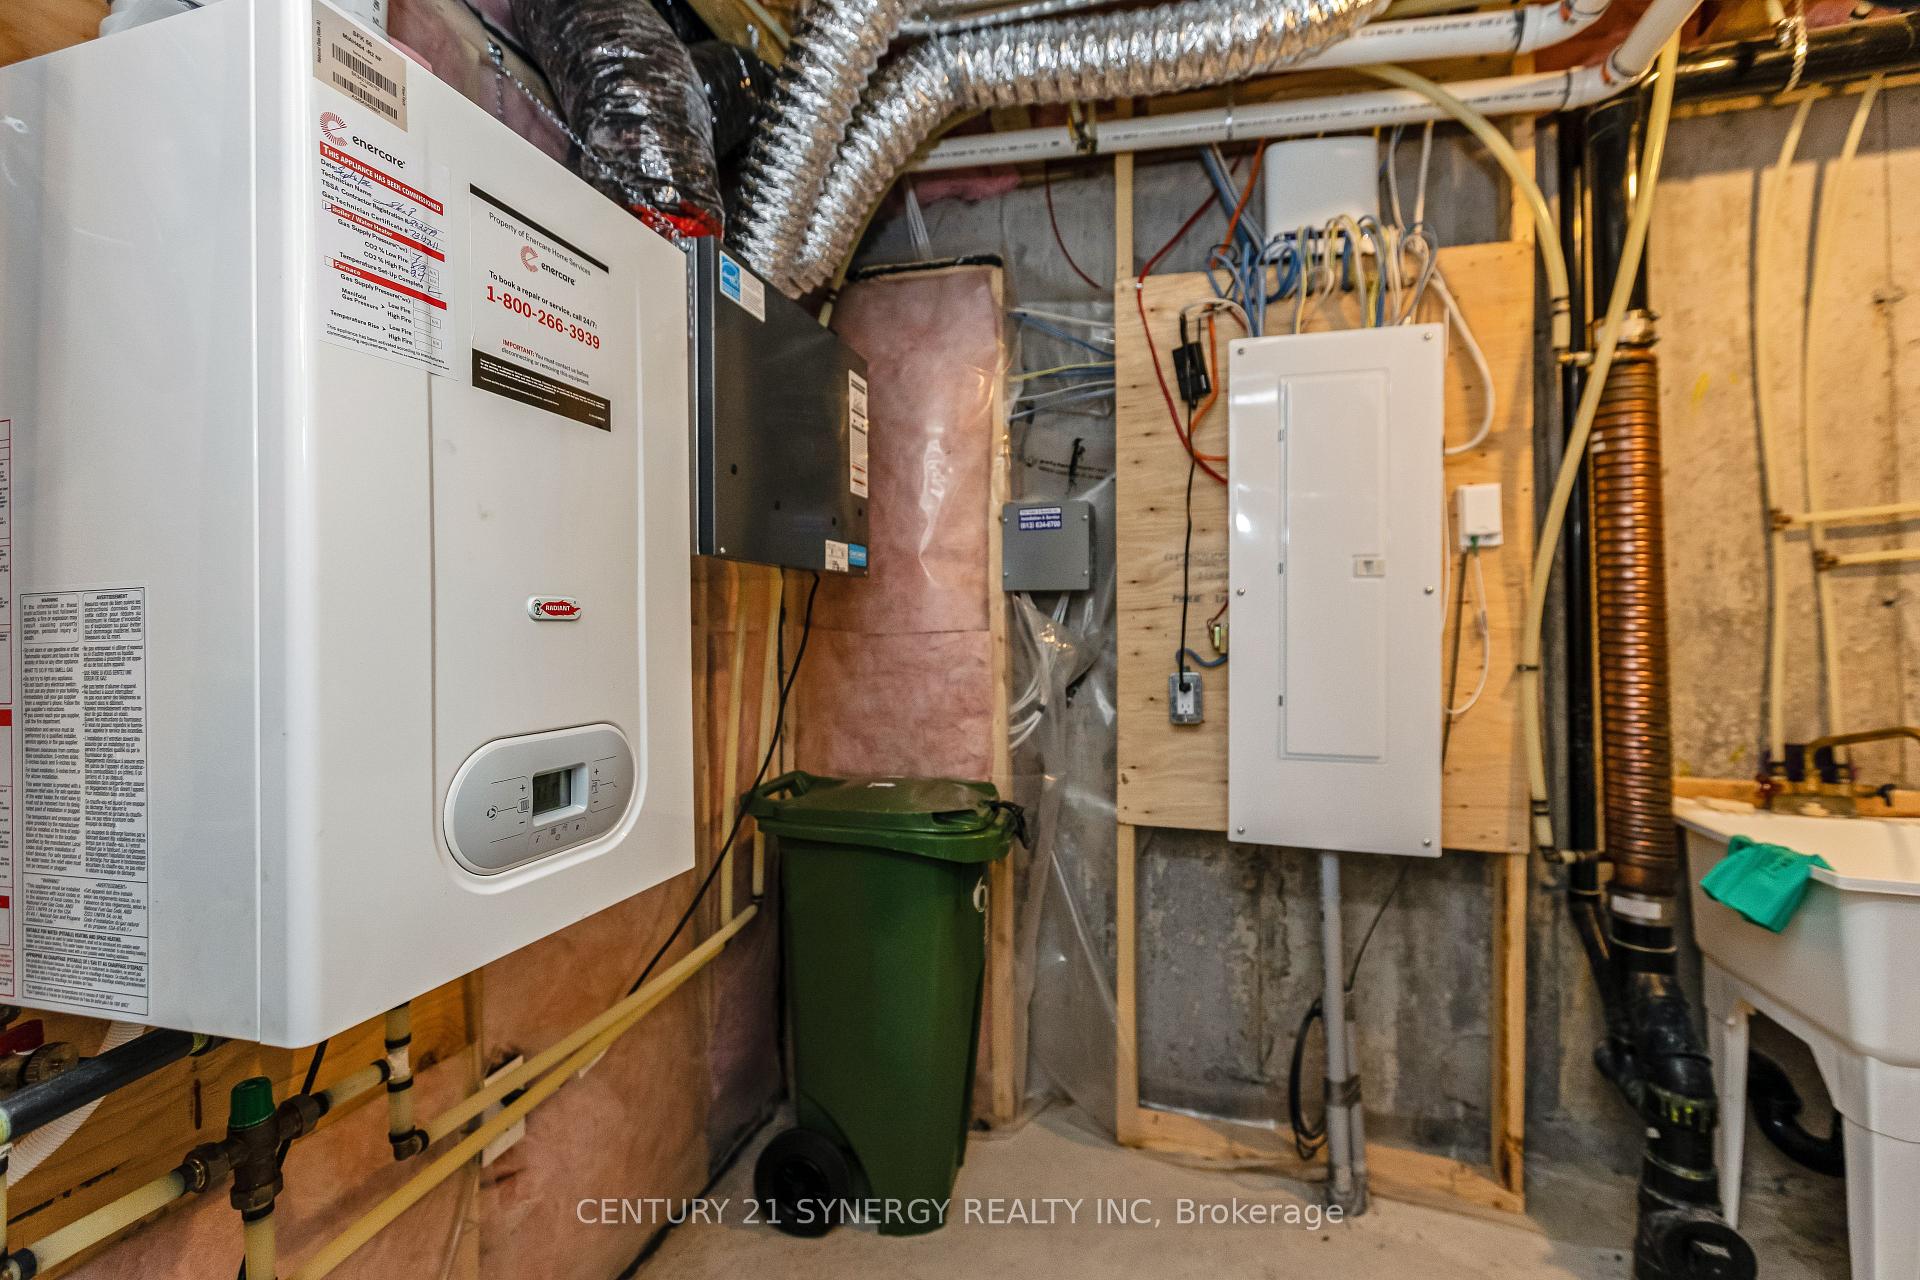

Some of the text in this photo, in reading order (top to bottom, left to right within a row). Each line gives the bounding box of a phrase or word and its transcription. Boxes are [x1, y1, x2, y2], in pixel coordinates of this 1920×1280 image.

[352, 136, 404, 168] enercare
[322, 169, 354, 188] Technician
[354, 184, 372, 197] Name
[340, 156, 372, 177] APPLIANCE
[374, 172, 386, 184] HAS
[386, 176, 400, 191] BEEN
[402, 184, 441, 211] COMMISSIONED
[322, 179, 340, 192] TSSA
[341, 188, 372, 206] Contractor
[372, 201, 404, 222] Registration
[322, 190, 334, 200] Gas
[335, 196, 370, 217] Technician
[371, 211, 403, 232] Certificate
[332, 205, 352, 218] Boiler
[356, 214, 373, 227] Water
[374, 222, 392, 237] Heater
[338, 218, 350, 228] Gas
[352, 224, 372, 239] Supply
[364, 241, 378, 251] CO2
[385, 250, 397, 259] Low
[489, 212, 591, 276] Property of Enercare Home Services
[335, 262, 362, 276] Furnace
[340, 252, 377, 271] Temperature
[398, 274, 424, 290] Complete
[364, 251, 377, 260] CO2
[384, 259, 398, 270] High
[340, 274, 353, 282] Gas
[354, 278, 374, 290] Supply
[541, 262, 576, 286] enercare
[342, 288, 366, 301] Manifold
[342, 294, 378, 310] Gas Pressure
[489, 270, 498, 280] To
[498, 274, 516, 290] book
[522, 288, 541, 302] repair
[542, 297, 549, 306] or
[549, 300, 572, 318] service,
[572, 312, 582, 322] call
[583, 316, 598, 330] 24/7:
[388, 302, 400, 310] Low
[388, 311, 400, 320] High
[330, 310, 380, 330] Temperature Rise
[389, 324, 400, 332] Low
[486, 285, 600, 350] 1-800-266-3939
[388, 334, 400, 342] High
[502, 338, 536, 358] IMPORTANT:
[535, 352, 544, 362] You
[555, 360, 570, 372] contact
[540, 362, 560, 376] removing
